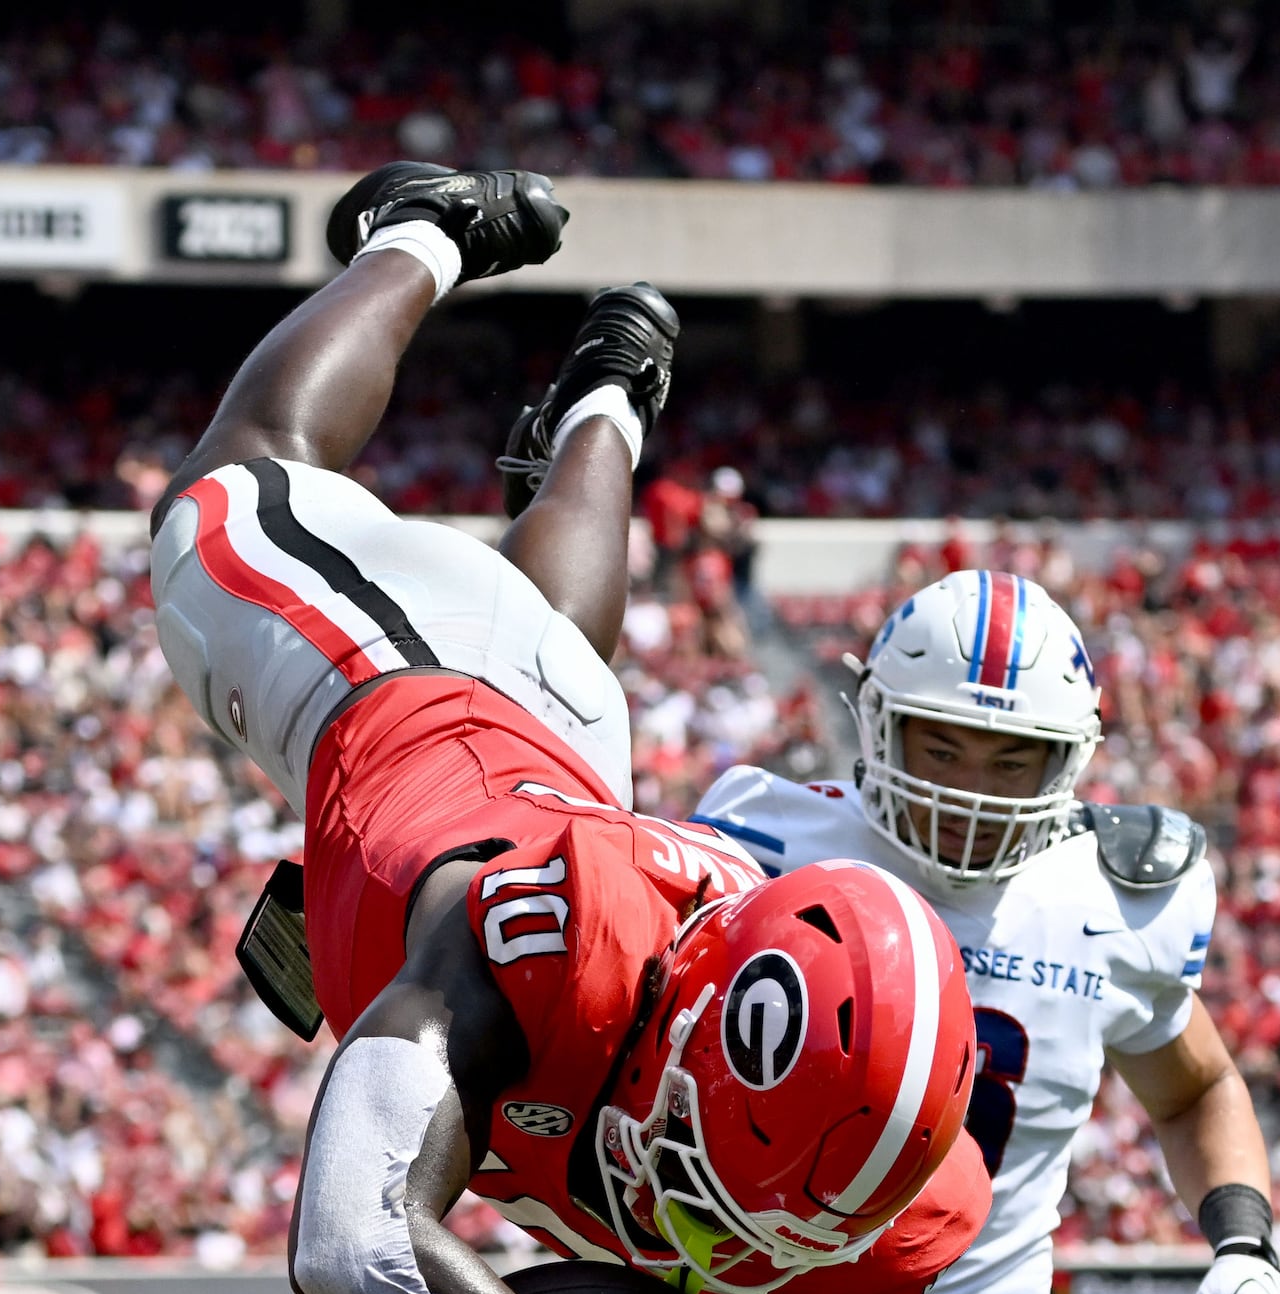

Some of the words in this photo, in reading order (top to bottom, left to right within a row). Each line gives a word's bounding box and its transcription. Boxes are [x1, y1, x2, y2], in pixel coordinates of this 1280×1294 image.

[480, 854, 570, 966] 10
[1031, 959, 1105, 1001] STATE
[506, 1103, 570, 1136] SEC
